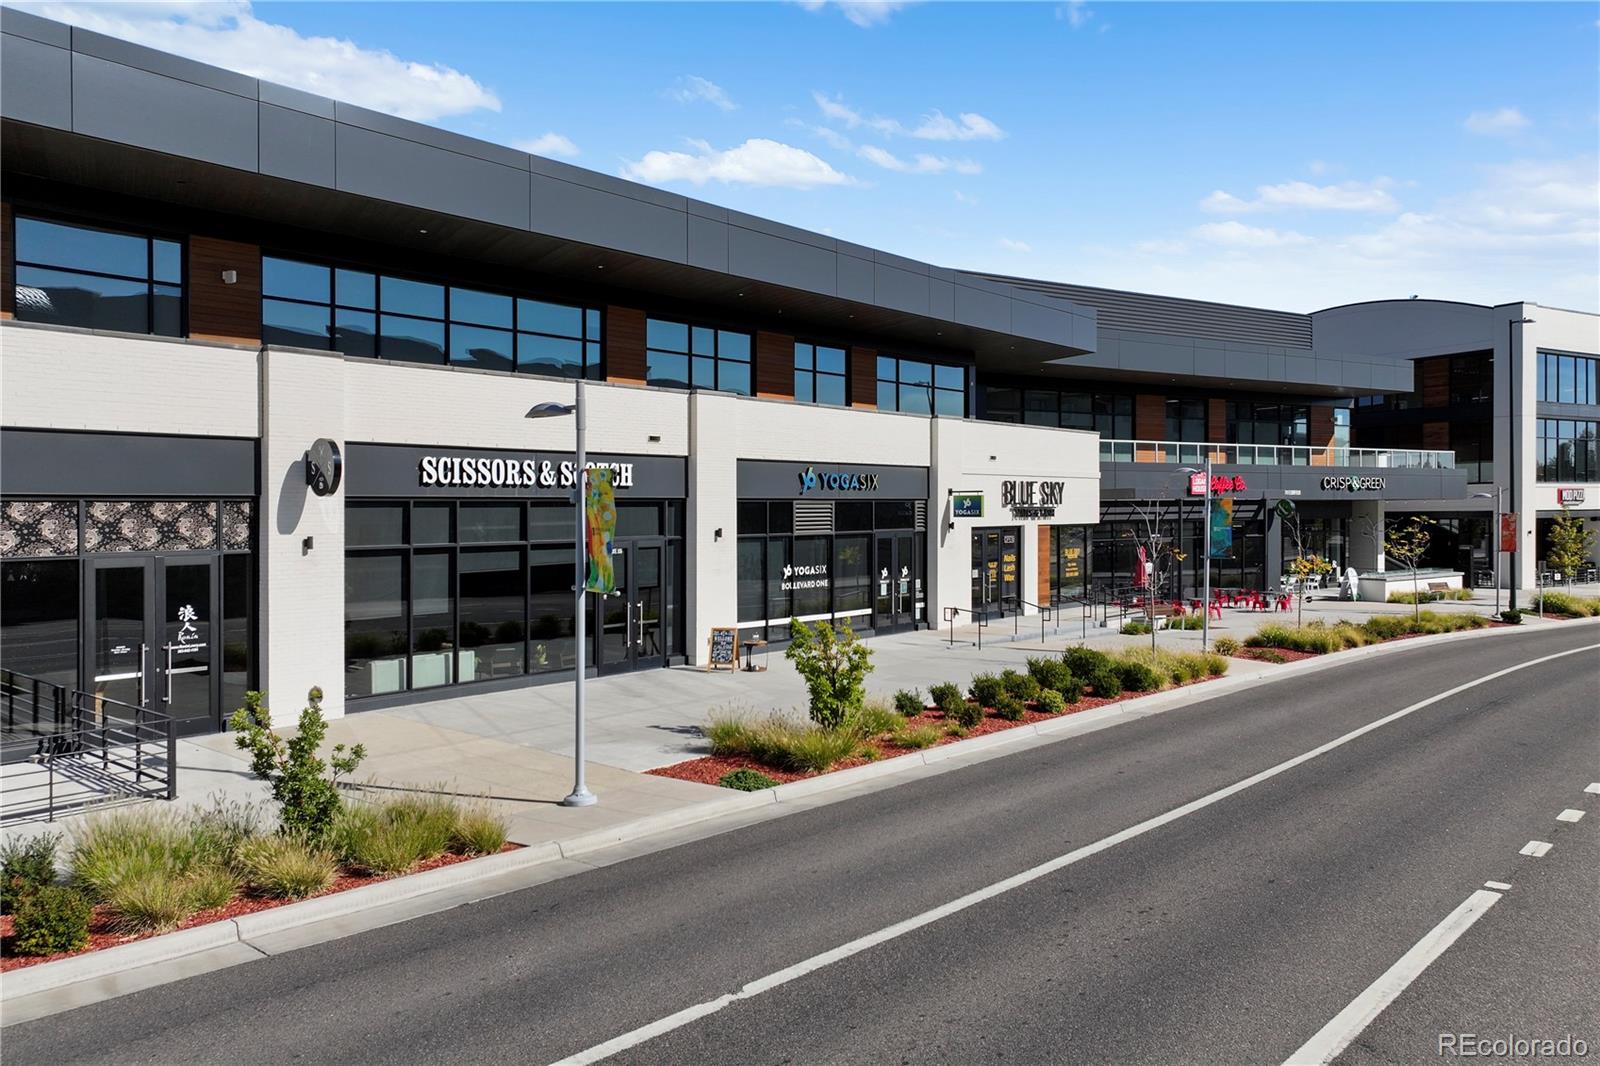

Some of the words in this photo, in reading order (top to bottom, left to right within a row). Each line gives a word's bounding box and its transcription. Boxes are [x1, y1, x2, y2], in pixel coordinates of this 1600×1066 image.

[421, 456, 536, 485] SCISSORS
[540, 460, 556, 486] &
[820, 472, 879, 490] YOGASIX
[1002, 480, 1038, 507] BLUE
[1039, 481, 1065, 506] SKY
[794, 565, 827, 576] YOGASIX
[816, 579, 828, 588] ONE
[178, 604, 198, 632] 浪人
